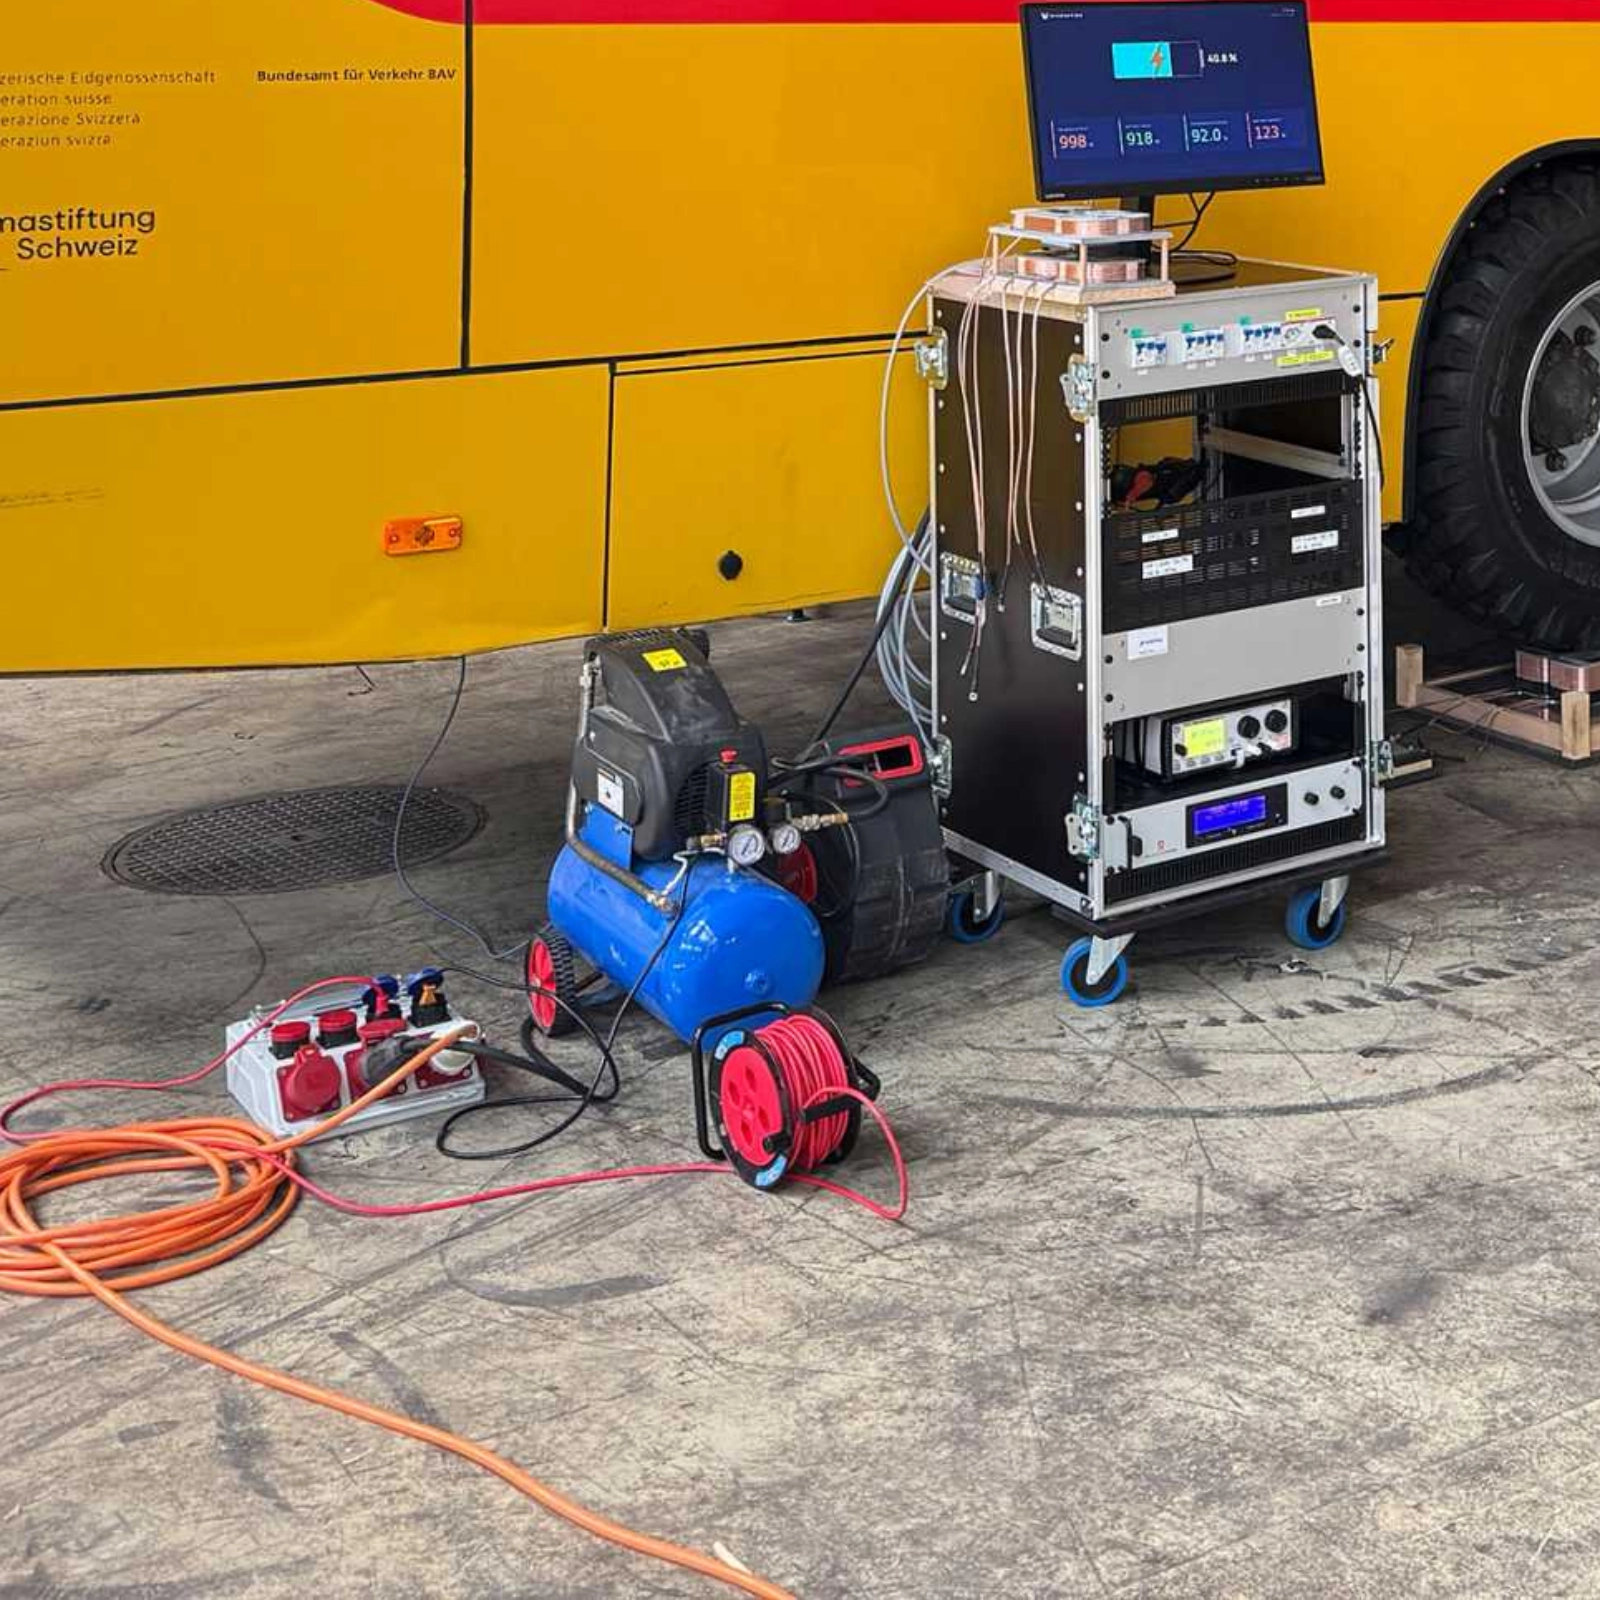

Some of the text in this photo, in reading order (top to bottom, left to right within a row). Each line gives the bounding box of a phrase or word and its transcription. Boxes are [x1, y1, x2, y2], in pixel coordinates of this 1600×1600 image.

[70, 70, 216, 87] Eidgenossenschaft
[257, 67, 457, 82] Bundesamt für Verkehr BAV
[65, 93, 112, 106] suisse
[76, 111, 141, 126] Svizzera
[1126, 131, 1153, 146] 918
[1191, 128, 1222, 143] 92.0
[1254, 125, 1280, 140] 123
[1059, 135, 1088, 150] 998
[17, 233, 138, 260] Schweiz
